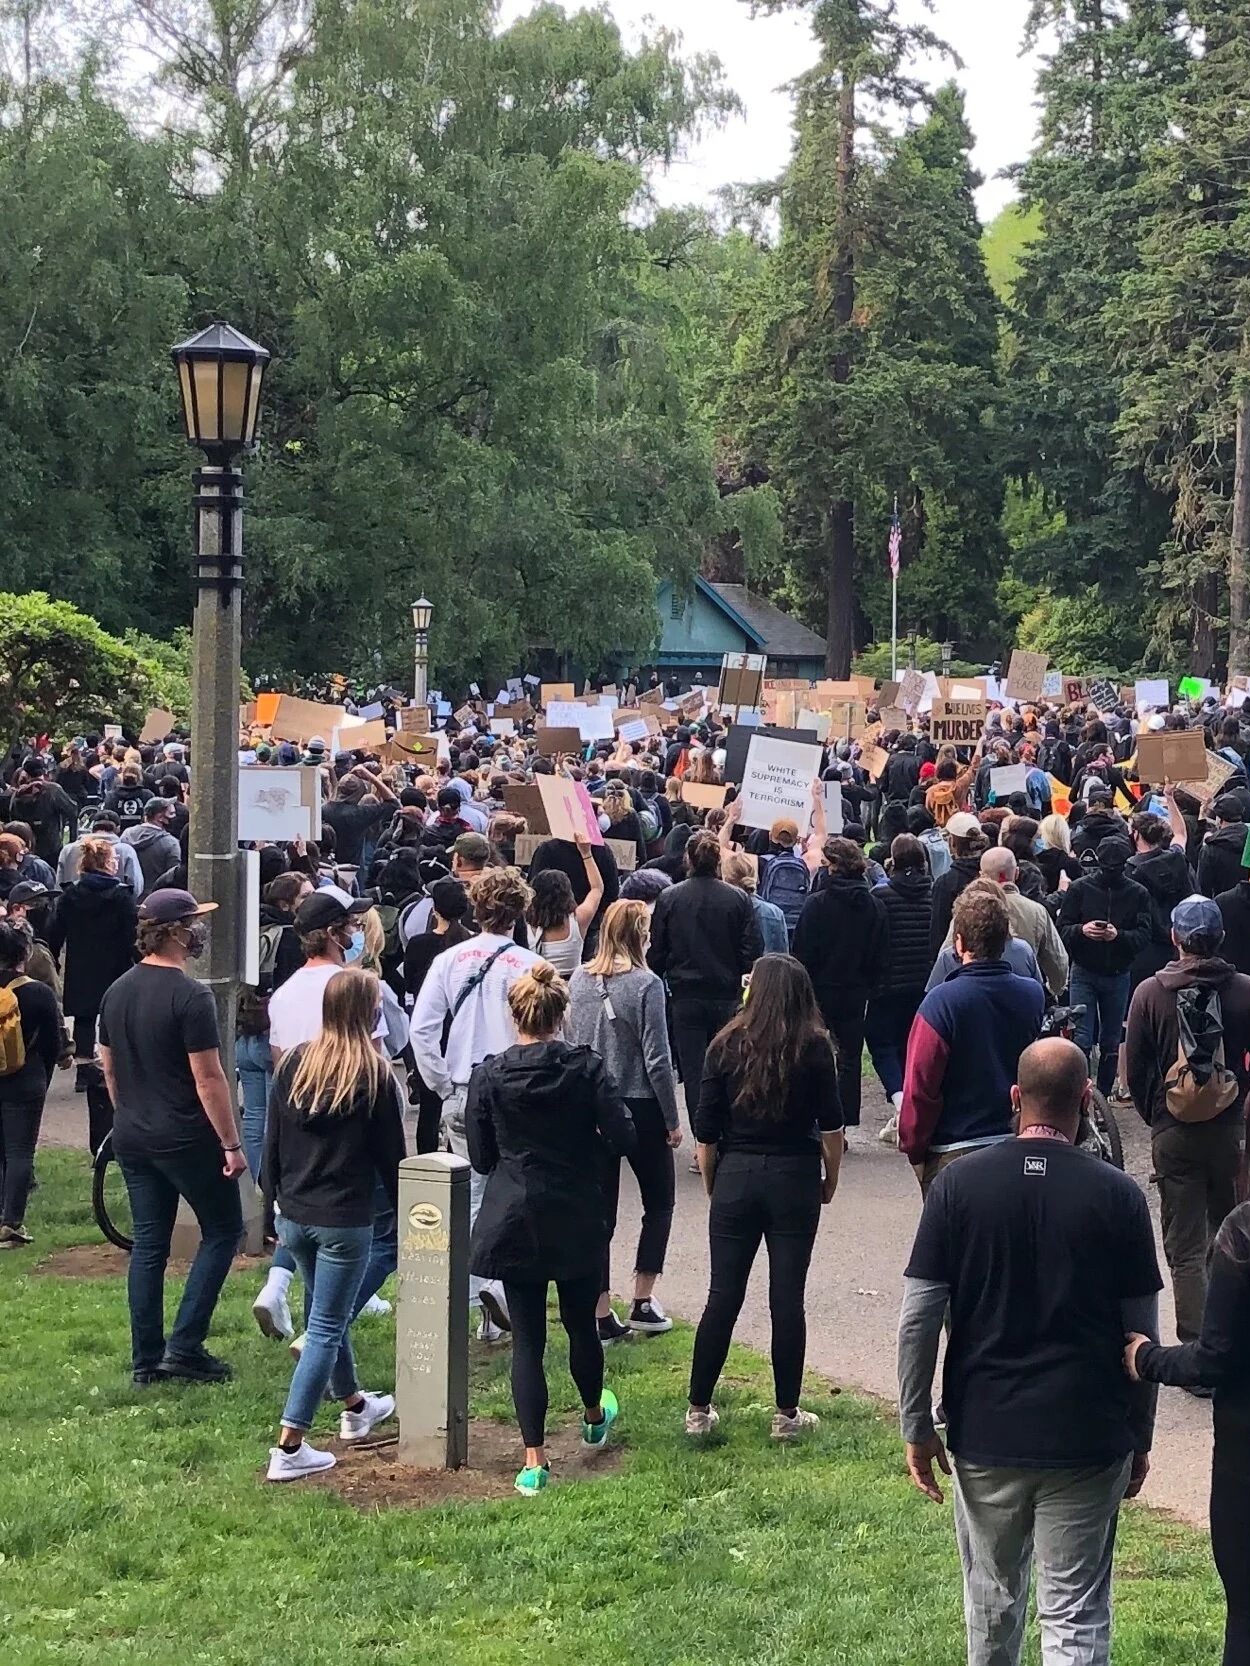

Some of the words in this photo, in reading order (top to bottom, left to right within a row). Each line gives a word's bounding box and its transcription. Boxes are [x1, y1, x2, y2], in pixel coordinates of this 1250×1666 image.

[1067, 682, 1090, 702] BL
[933, 719, 985, 741] MURDER
[767, 764, 797, 776] WHITE
[751, 771, 810, 788] SUPREMACY
[774, 786, 783, 794] IS
[749, 791, 804, 808] TERRORISM
